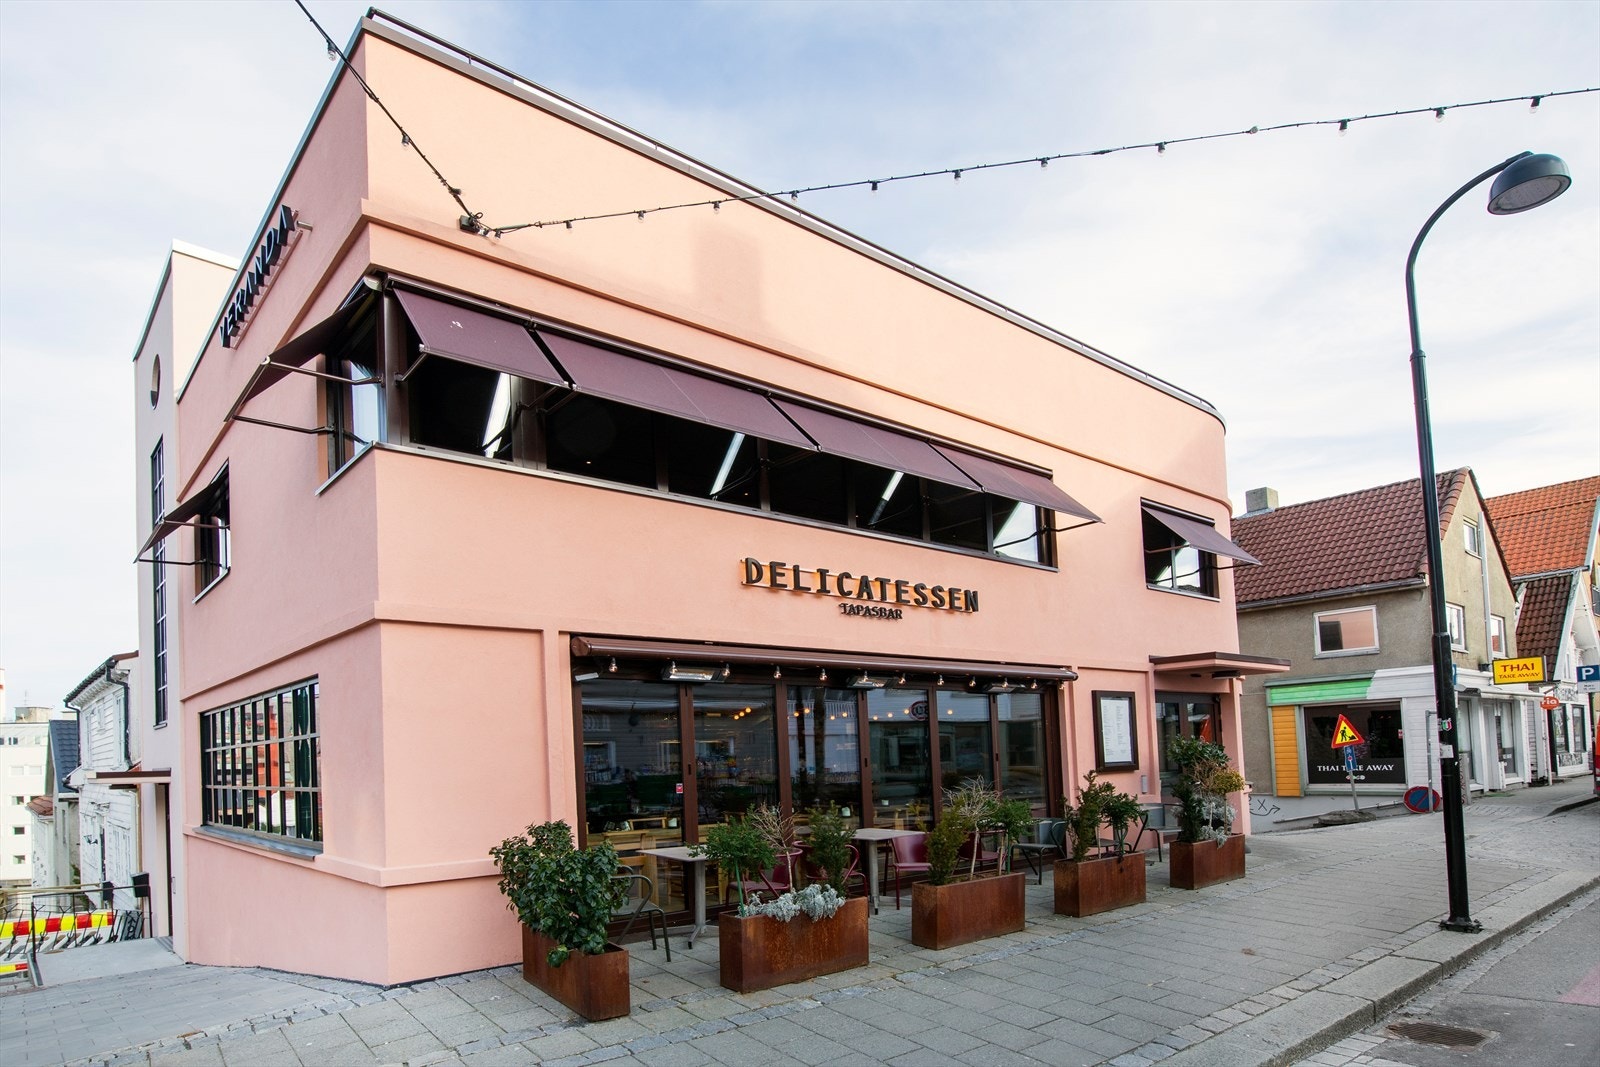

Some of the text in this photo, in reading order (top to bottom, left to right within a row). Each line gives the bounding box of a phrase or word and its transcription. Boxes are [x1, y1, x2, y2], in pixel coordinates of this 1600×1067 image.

[219, 204, 296, 348] VERANDA
[745, 557, 979, 612] DELICATESSEN
[839, 602, 903, 620] TAPASBAR
[1501, 663, 1535, 673] THAI
[1581, 667, 1594, 680] P
